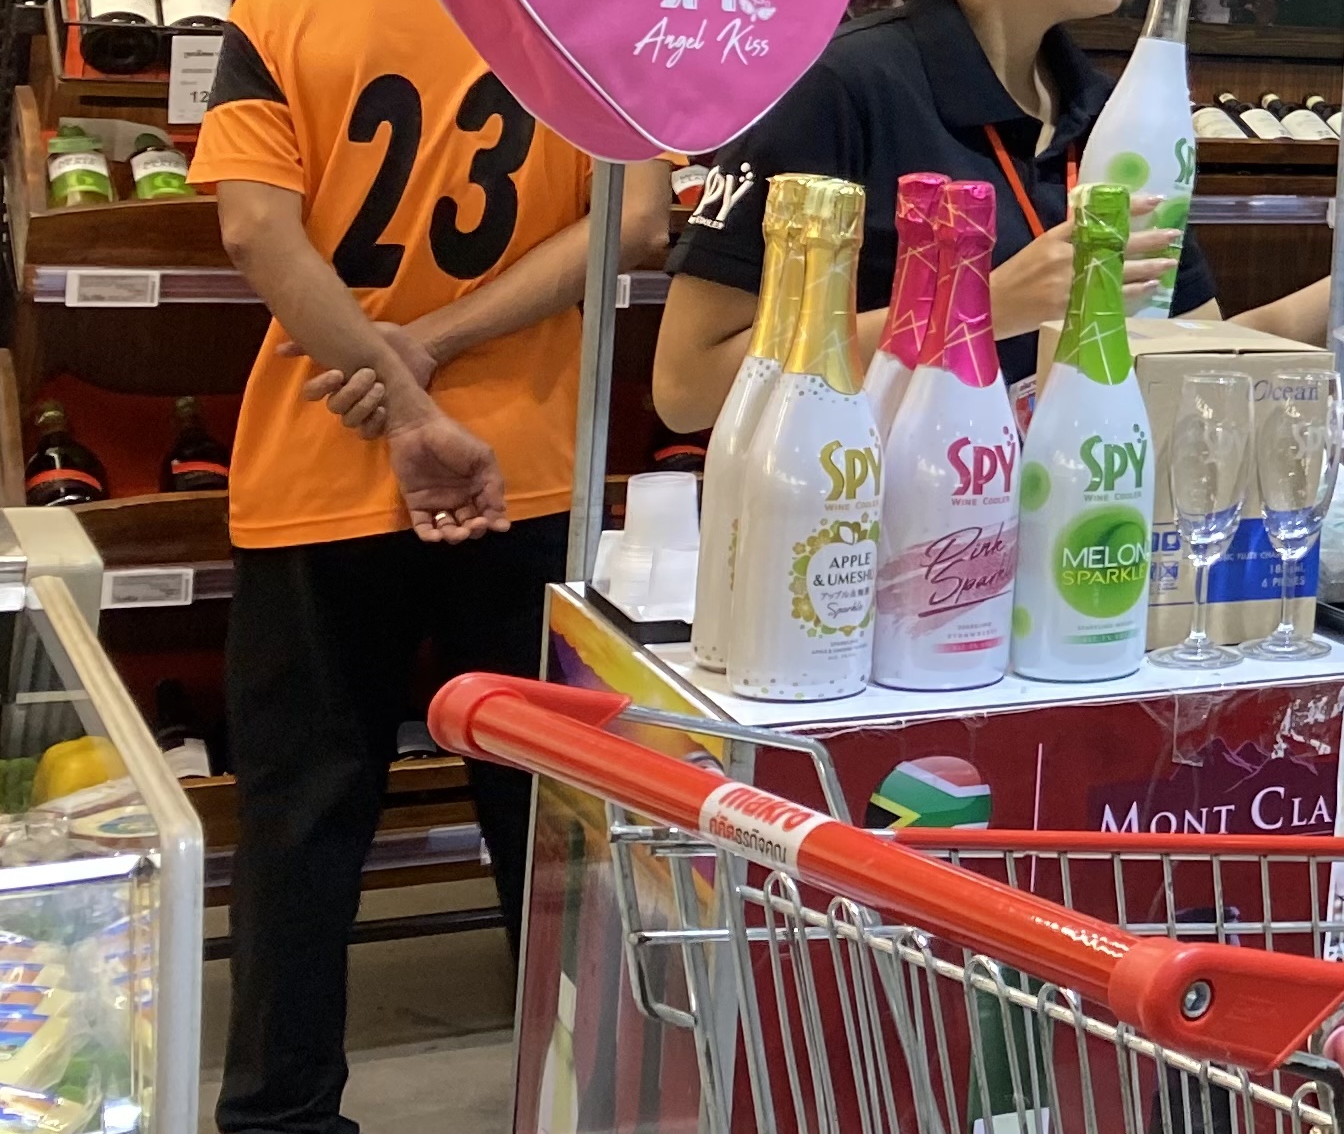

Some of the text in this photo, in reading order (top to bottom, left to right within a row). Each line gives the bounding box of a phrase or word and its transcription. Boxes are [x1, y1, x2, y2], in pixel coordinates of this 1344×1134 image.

[633, 17, 769, 68] Angel Kiss
[332, 73, 535, 288] 23
[688, 165, 754, 217] PY
[1251, 379, 1318, 401] Ocean
[819, 440, 881, 501] SPY
[947, 436, 1015, 496] SPY
[1080, 435, 1147, 492] SPY
[951, 497, 977, 506] WINE
[829, 552, 871, 569] APPLE
[920, 521, 1005, 581] Pink
[1063, 542, 1149, 568] MELON
[813, 574, 825, 586] &
[1062, 563, 1147, 586] SPARKLE
[1272, 577, 1306, 587] PIES
[718, 787, 815, 832] makro
[1251, 786, 1333, 830] CLA
